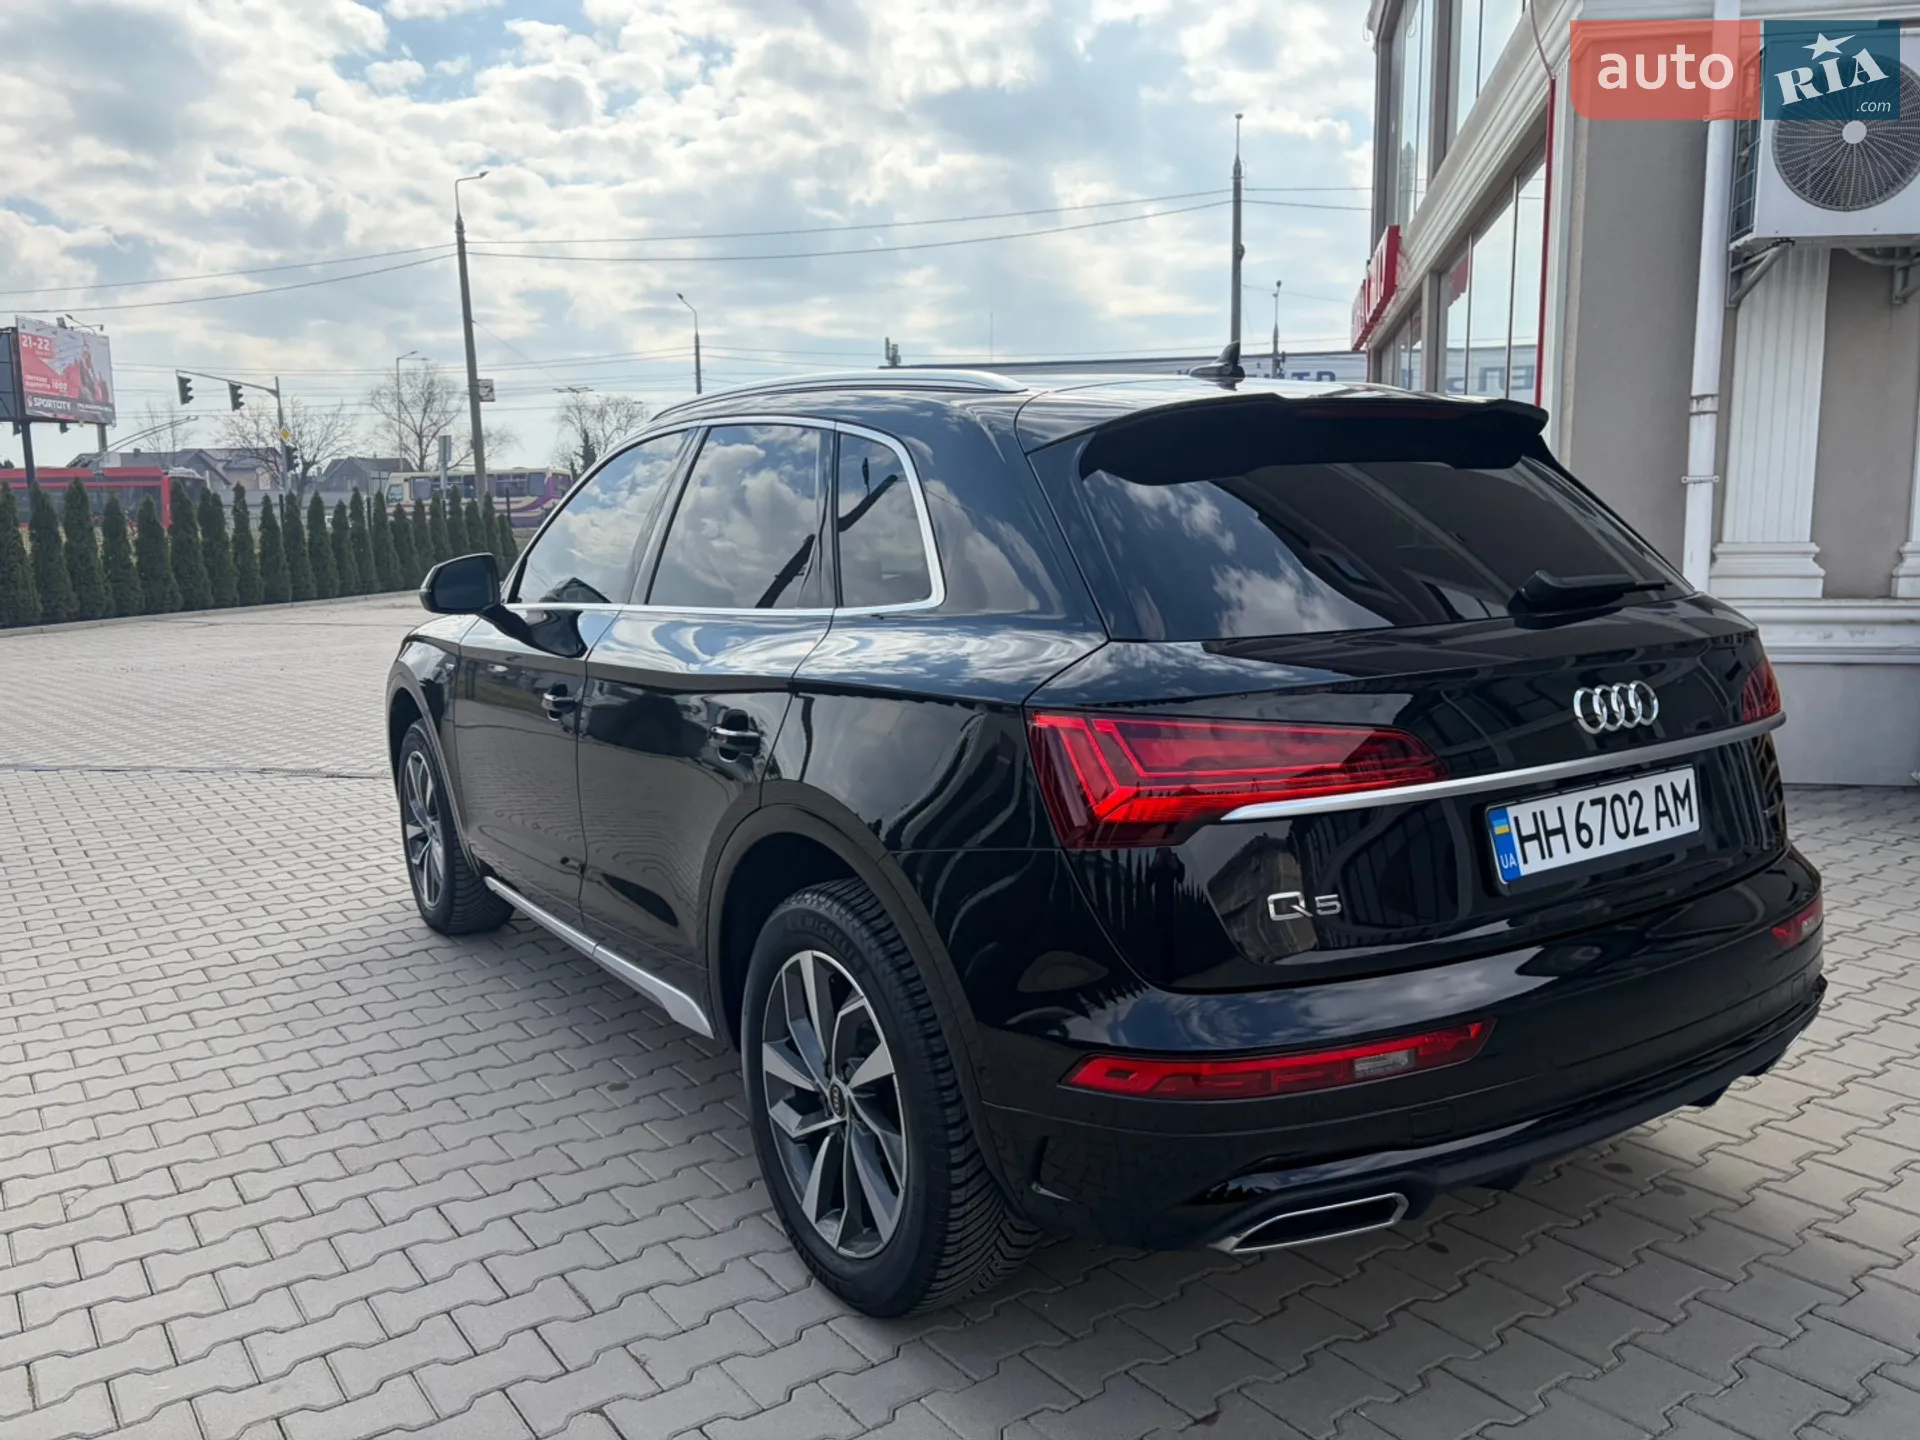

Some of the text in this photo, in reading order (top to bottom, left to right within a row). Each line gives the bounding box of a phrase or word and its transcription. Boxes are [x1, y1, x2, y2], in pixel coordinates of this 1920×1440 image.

[1513, 778, 1695, 864] HH 6702 AM
[1500, 854, 1517, 869] UA
[1267, 891, 1342, 921] Q5
